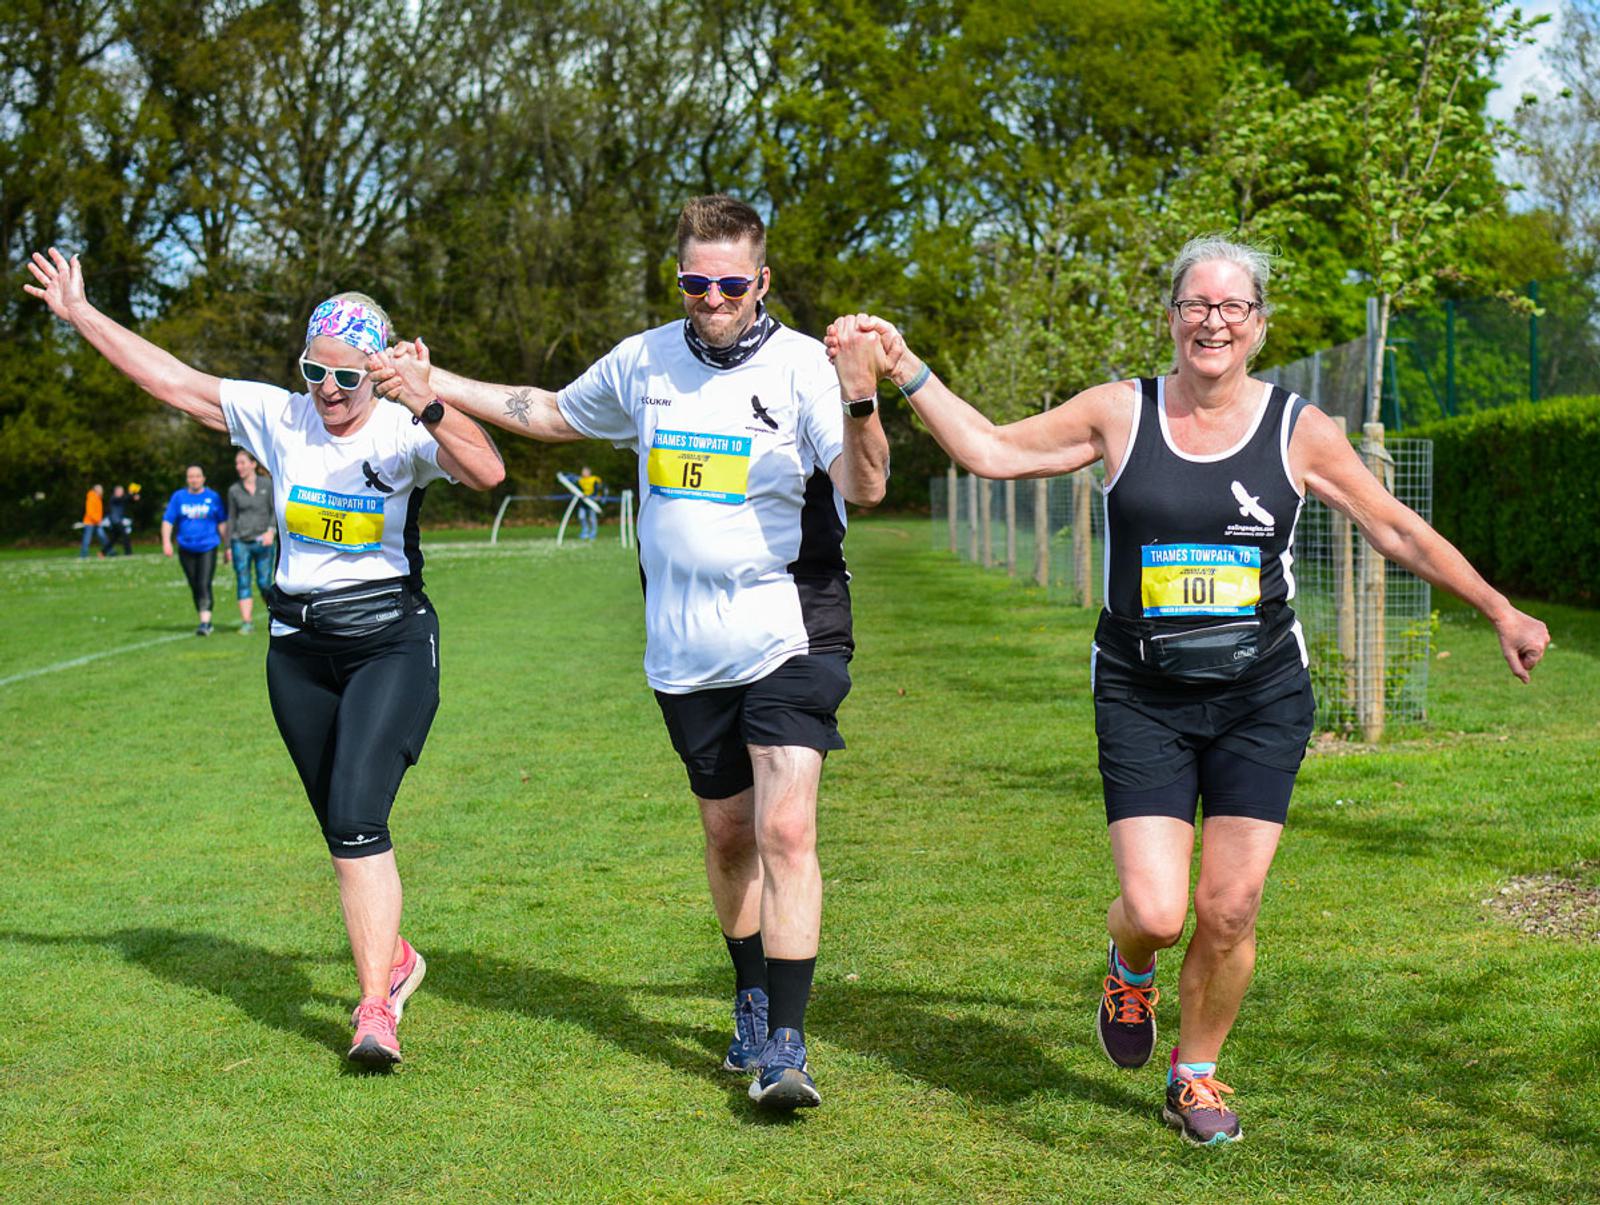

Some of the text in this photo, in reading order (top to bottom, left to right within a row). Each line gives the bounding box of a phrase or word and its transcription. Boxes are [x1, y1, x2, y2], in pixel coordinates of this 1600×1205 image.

[688, 436, 728, 451] TOWPATH
[731, 440, 742, 452] 10
[682, 462, 703, 488] 15
[297, 488, 326, 505] THAMES
[366, 500, 376, 510] 10
[321, 517, 343, 542] 76
[1151, 549, 1251, 563] THAMES TOWPATH 10
[1183, 577, 1215, 604] 101
